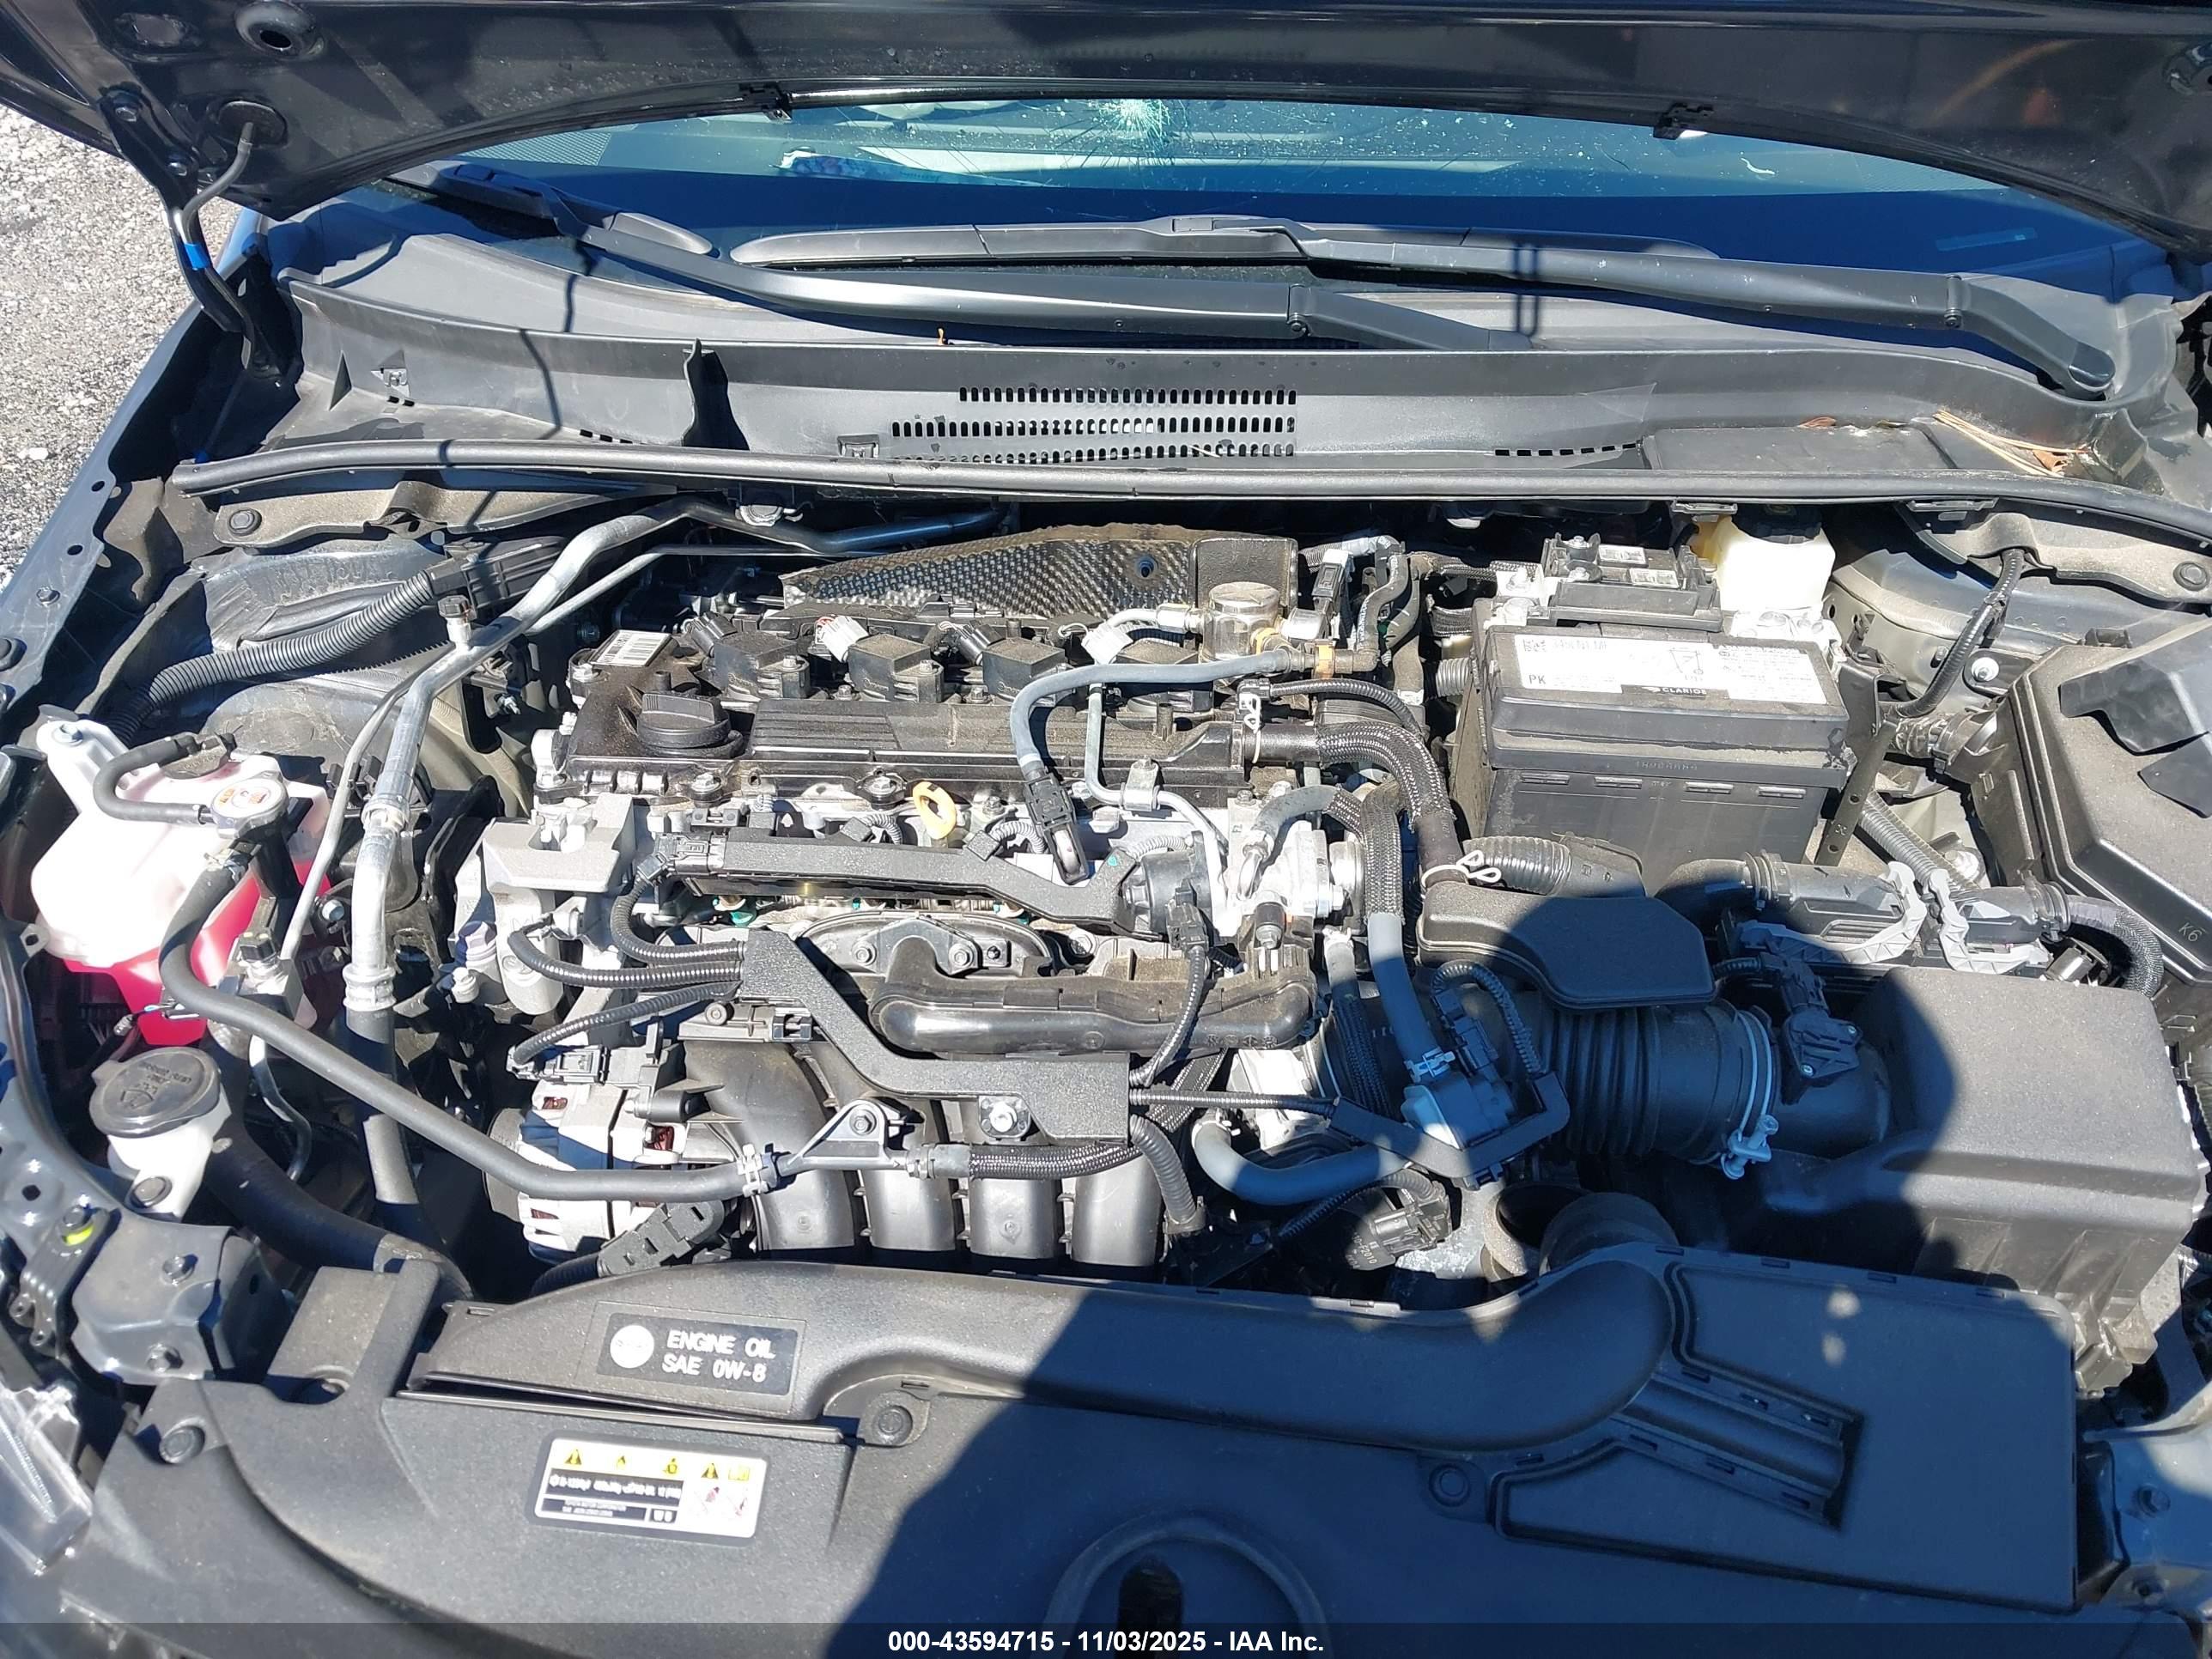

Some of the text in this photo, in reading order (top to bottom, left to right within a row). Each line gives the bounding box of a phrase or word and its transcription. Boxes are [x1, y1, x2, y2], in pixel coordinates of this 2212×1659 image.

[1528, 674, 1547, 685] PK
[666, 1329, 776, 1359] ENGINE OIL
[661, 1352, 768, 1382] SAE 0W-8
